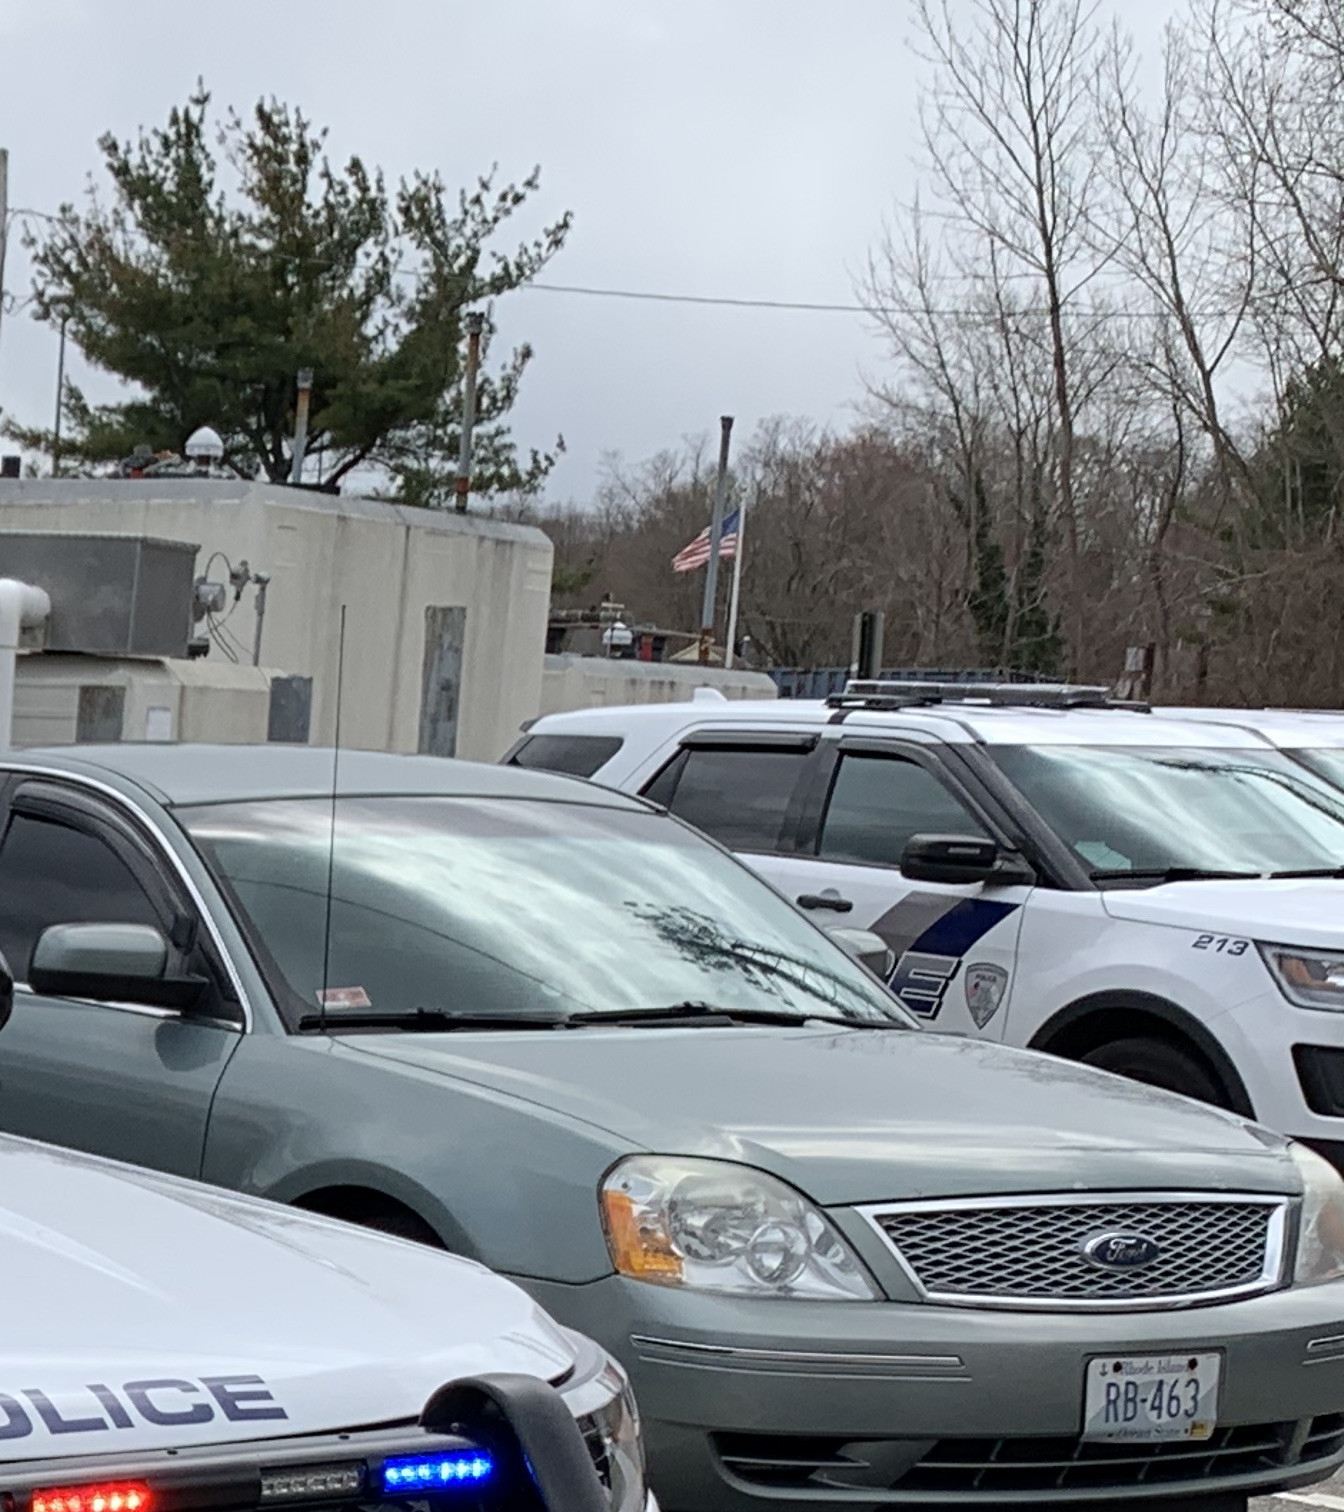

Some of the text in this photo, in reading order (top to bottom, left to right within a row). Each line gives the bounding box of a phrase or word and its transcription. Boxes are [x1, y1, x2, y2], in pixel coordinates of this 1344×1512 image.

[1192, 934, 1249, 956] 213
[1107, 1238, 1148, 1261] Ford
[1105, 1379, 1200, 1423] RB-463
